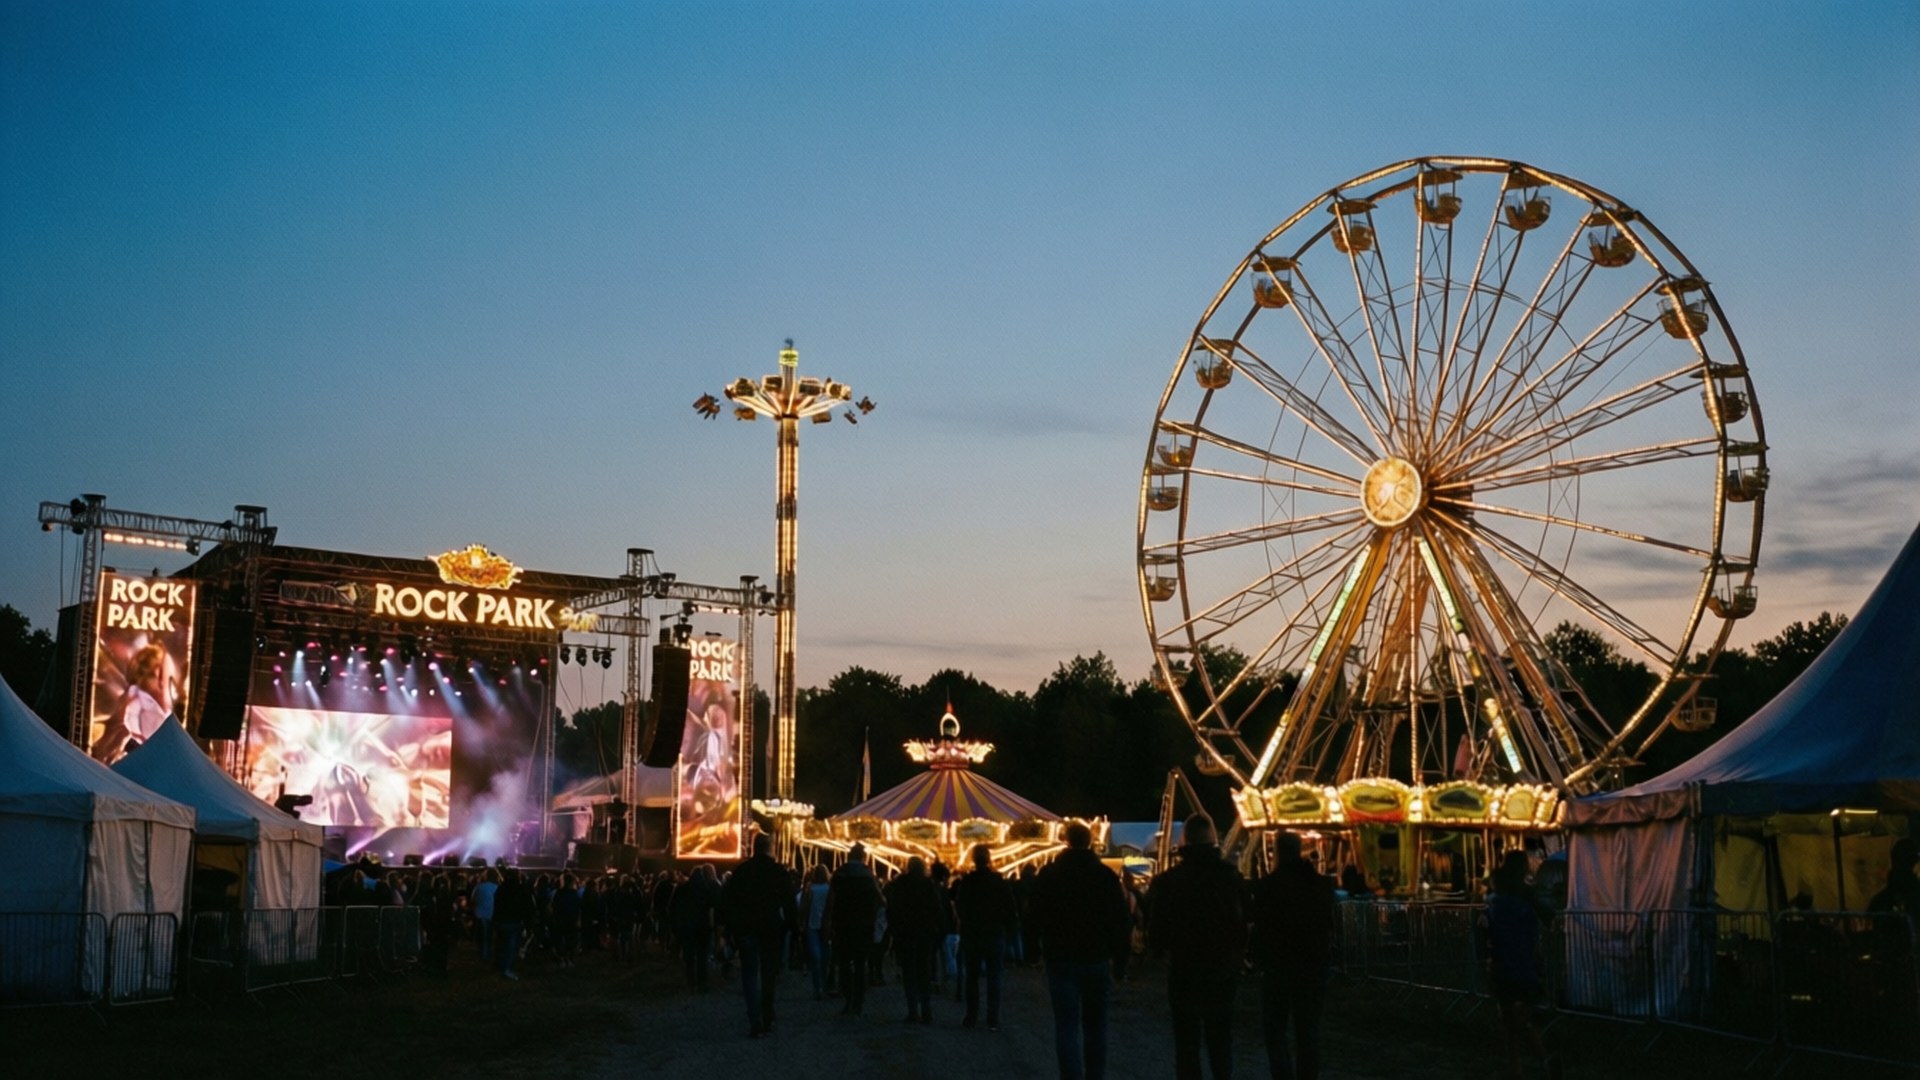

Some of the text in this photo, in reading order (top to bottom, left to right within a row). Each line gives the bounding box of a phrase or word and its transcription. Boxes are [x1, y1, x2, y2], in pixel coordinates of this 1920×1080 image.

[110, 578, 186, 607] ROCK
[375, 583, 555, 629] ROCK PARK
[107, 603, 176, 632] PARK
[689, 659, 735, 682] PARK
